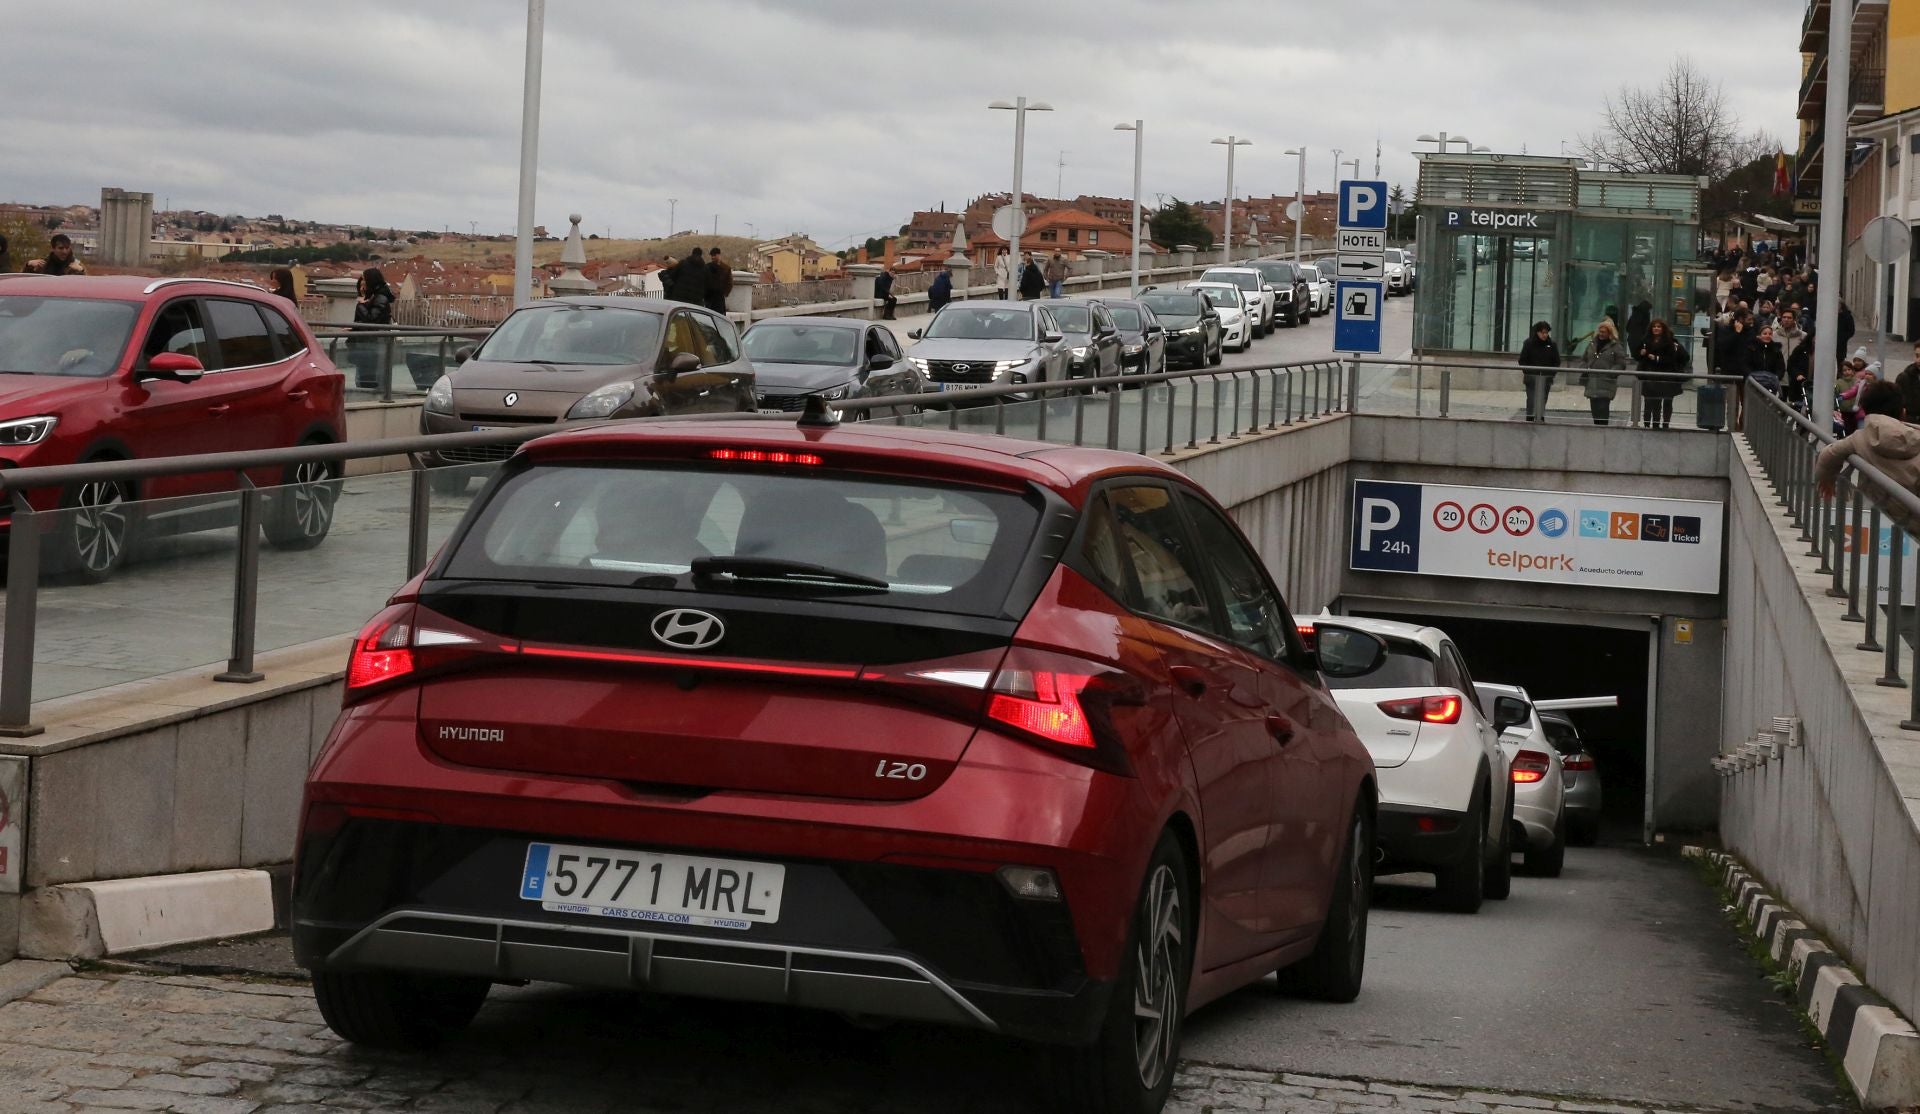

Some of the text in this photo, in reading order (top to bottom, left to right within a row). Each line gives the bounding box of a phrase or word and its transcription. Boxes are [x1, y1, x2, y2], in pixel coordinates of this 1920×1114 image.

[1348, 186, 1377, 222] P
[1448, 210, 1538, 229] P telpark
[1342, 235, 1380, 247] HOTEL
[1442, 511, 1457, 521] 20
[1360, 497, 1401, 551] P
[1673, 533, 1699, 543] Ticket
[1381, 540, 1410, 554] 24h
[1487, 548, 1575, 573] telpark
[1579, 566, 1616, 575] Acueducto
[439, 726, 504, 742] HYUNDAI
[528, 877, 538, 889] E
[554, 854, 766, 915] 5771 MRL
[557, 904, 590, 913] HYUNDAI
[601, 907, 690, 923] CARS COREA.COM
[714, 919, 747, 928] HYUNDAI
